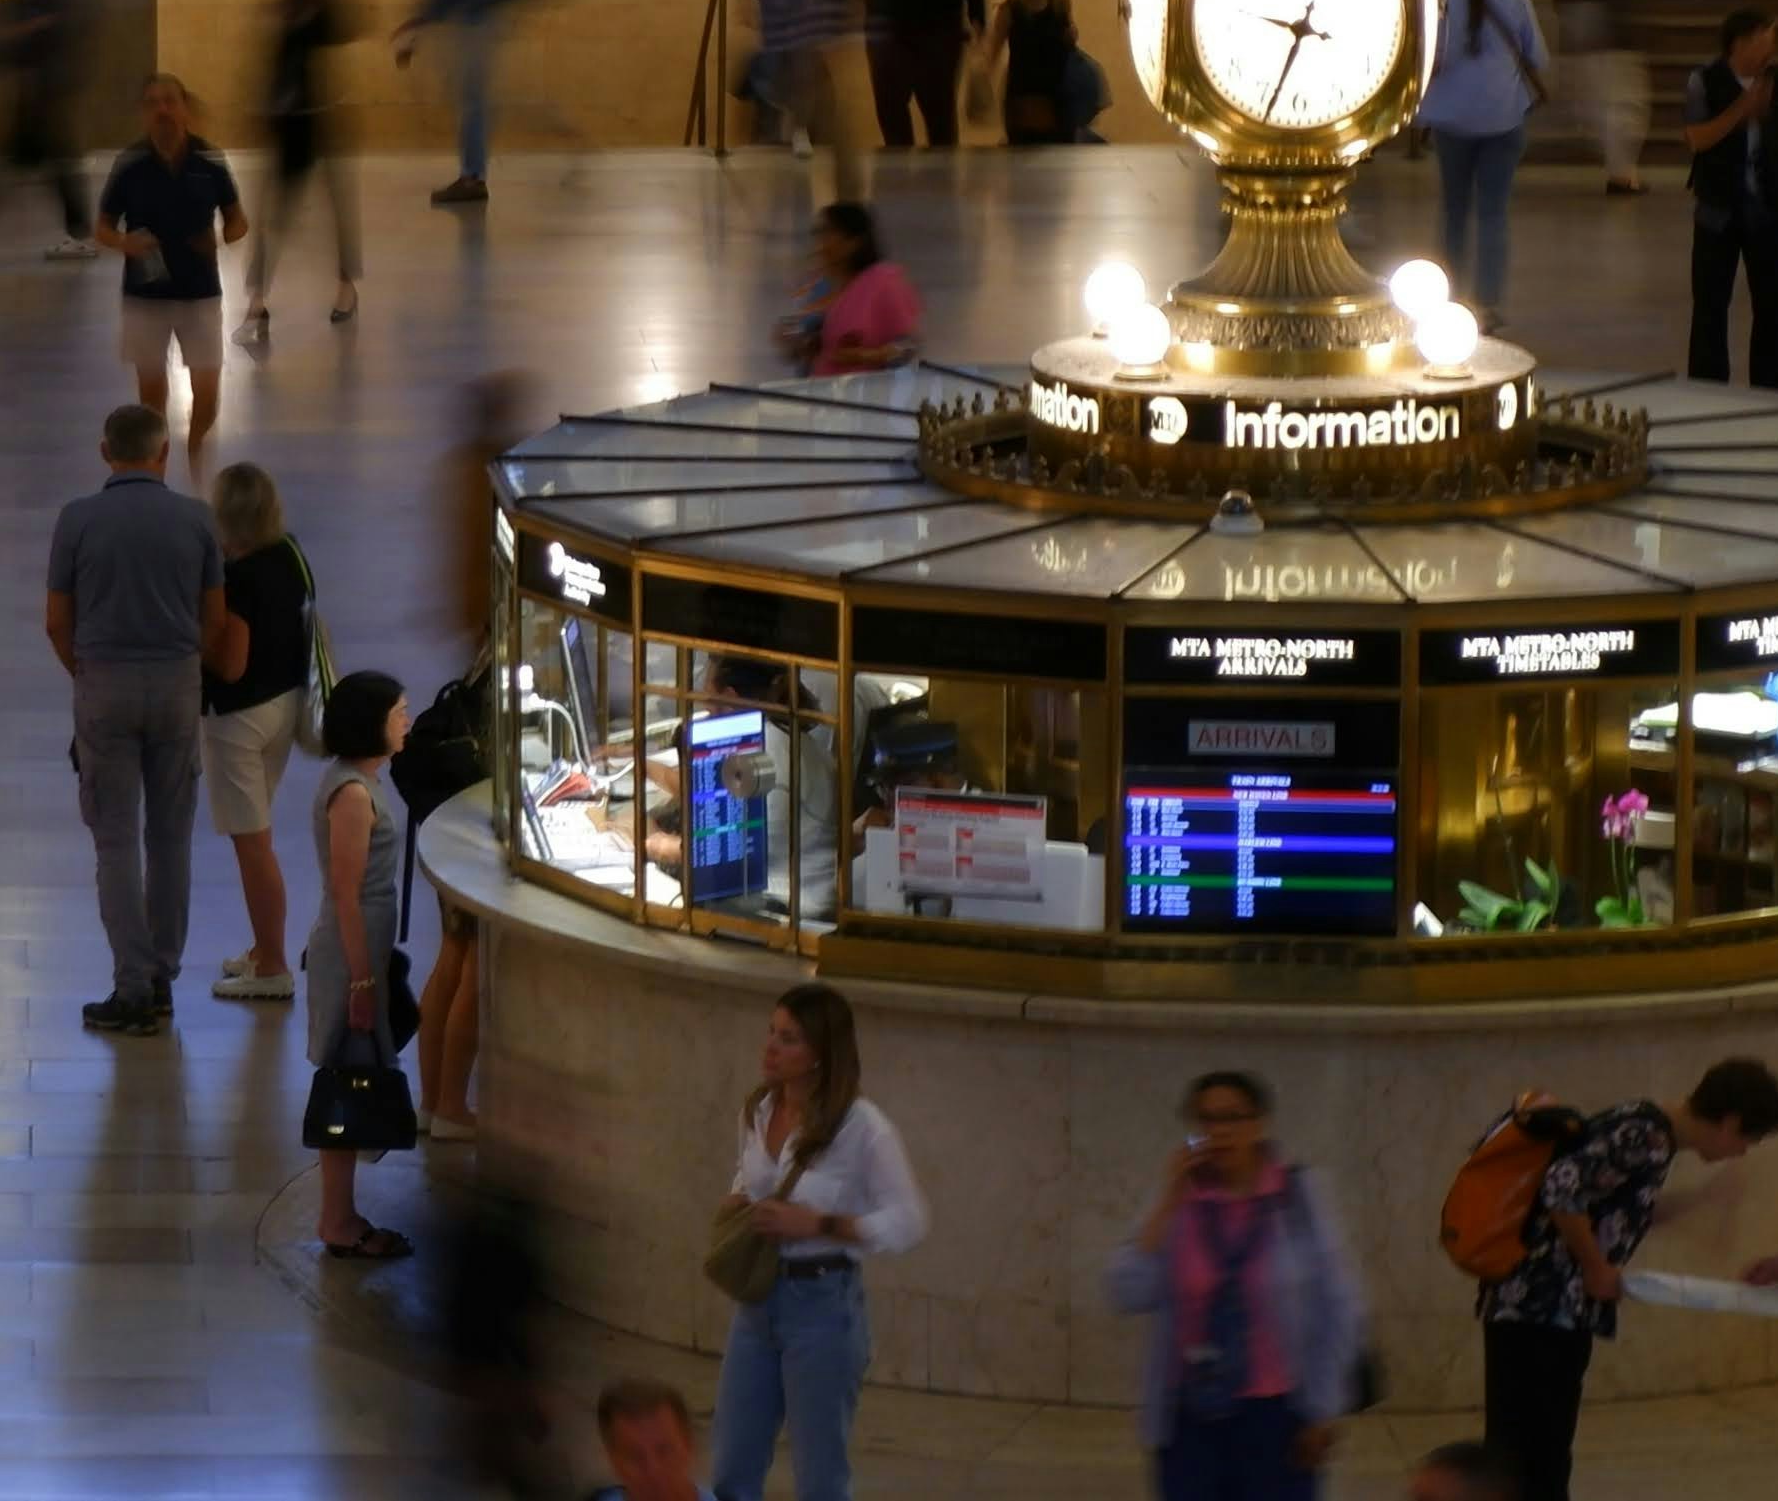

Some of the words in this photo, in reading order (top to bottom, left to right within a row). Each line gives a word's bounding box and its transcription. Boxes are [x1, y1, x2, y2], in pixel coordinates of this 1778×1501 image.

[1031, 381, 1099, 435] mation
[1225, 399, 1459, 449] Information
[1729, 619, 1760, 642] MTA
[1170, 637, 1211, 657] MTA
[1215, 637, 1354, 660] METRO-NORTH
[1461, 637, 1500, 658] MTA
[1504, 630, 1635, 654] METRO-NORTH
[1218, 657, 1307, 676] ARRIVALS
[1496, 651, 1600, 673] TIMETABLES
[1196, 725, 1328, 750] ARRIVALS
